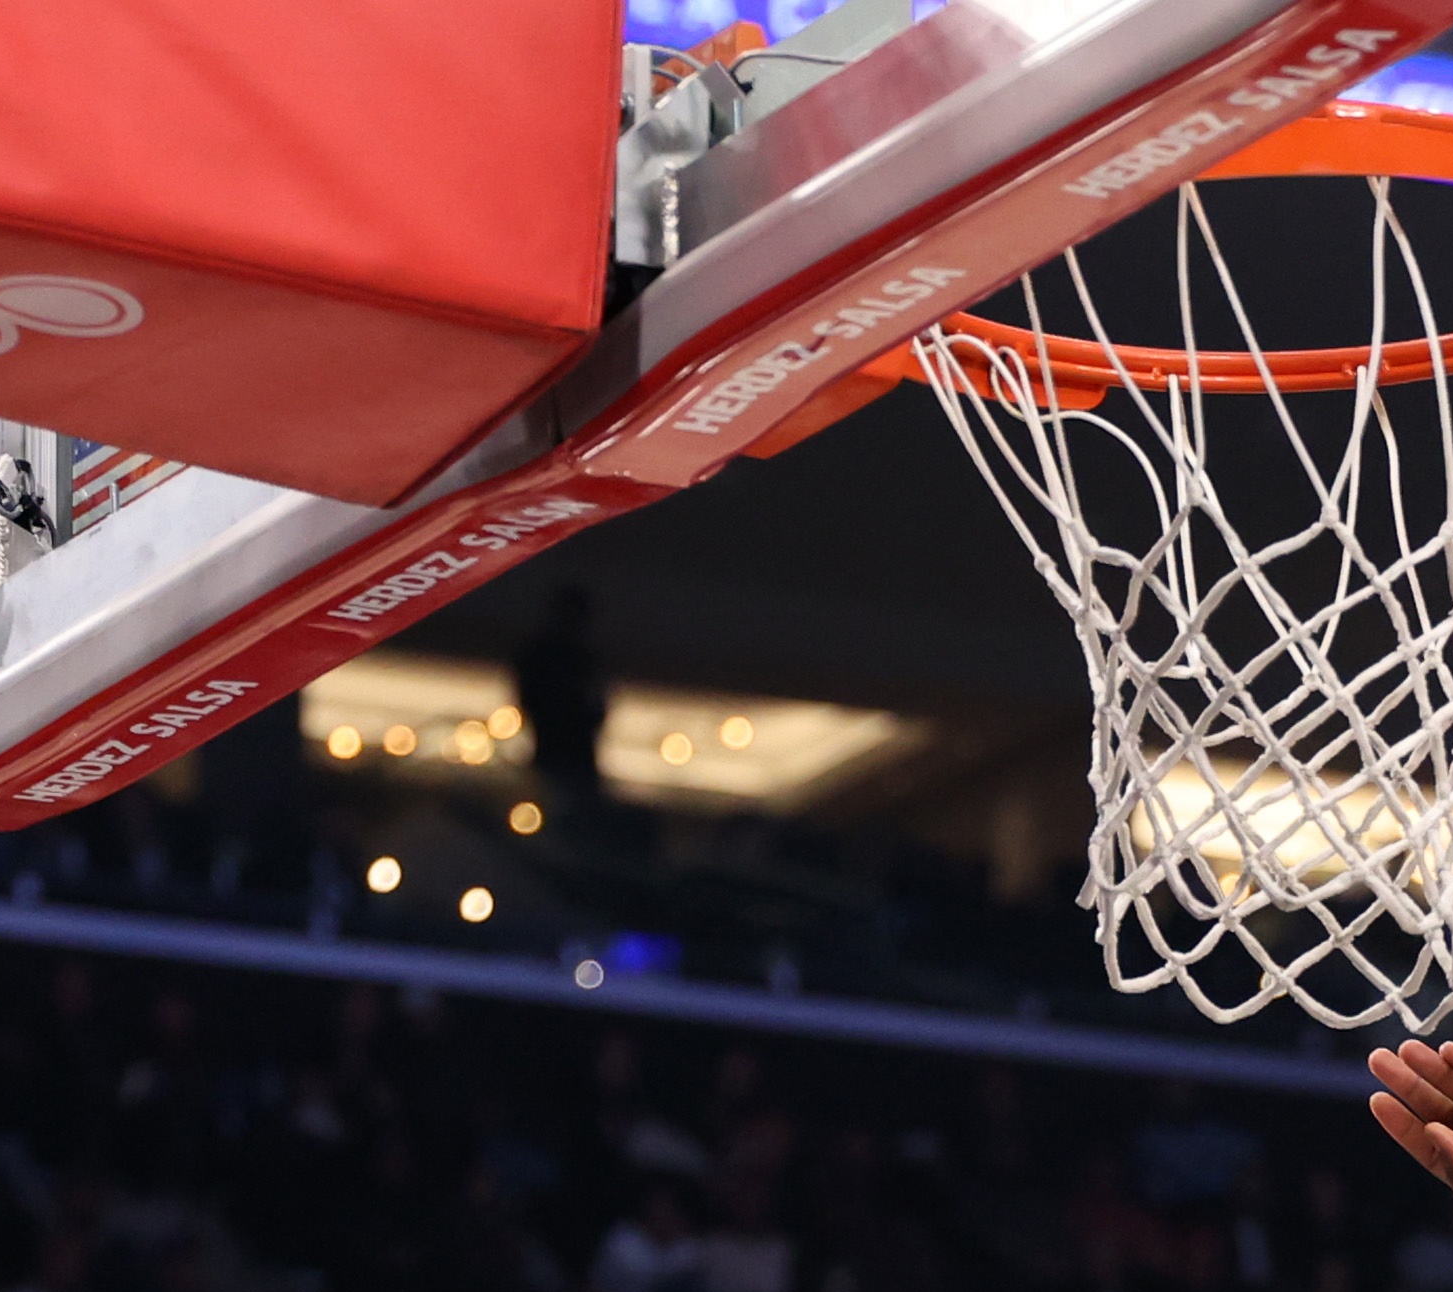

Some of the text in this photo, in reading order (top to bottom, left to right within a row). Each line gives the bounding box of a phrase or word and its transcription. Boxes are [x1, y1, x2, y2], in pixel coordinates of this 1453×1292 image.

[1060, 111, 1244, 200] HERDEZ
[1227, 28, 1399, 111] SALSA
[673, 267, 967, 434] HERDEZ SALSA
[328, 498, 597, 622] HERDEZ SALSA
[12, 679, 260, 802] HERDEZ SALSA
